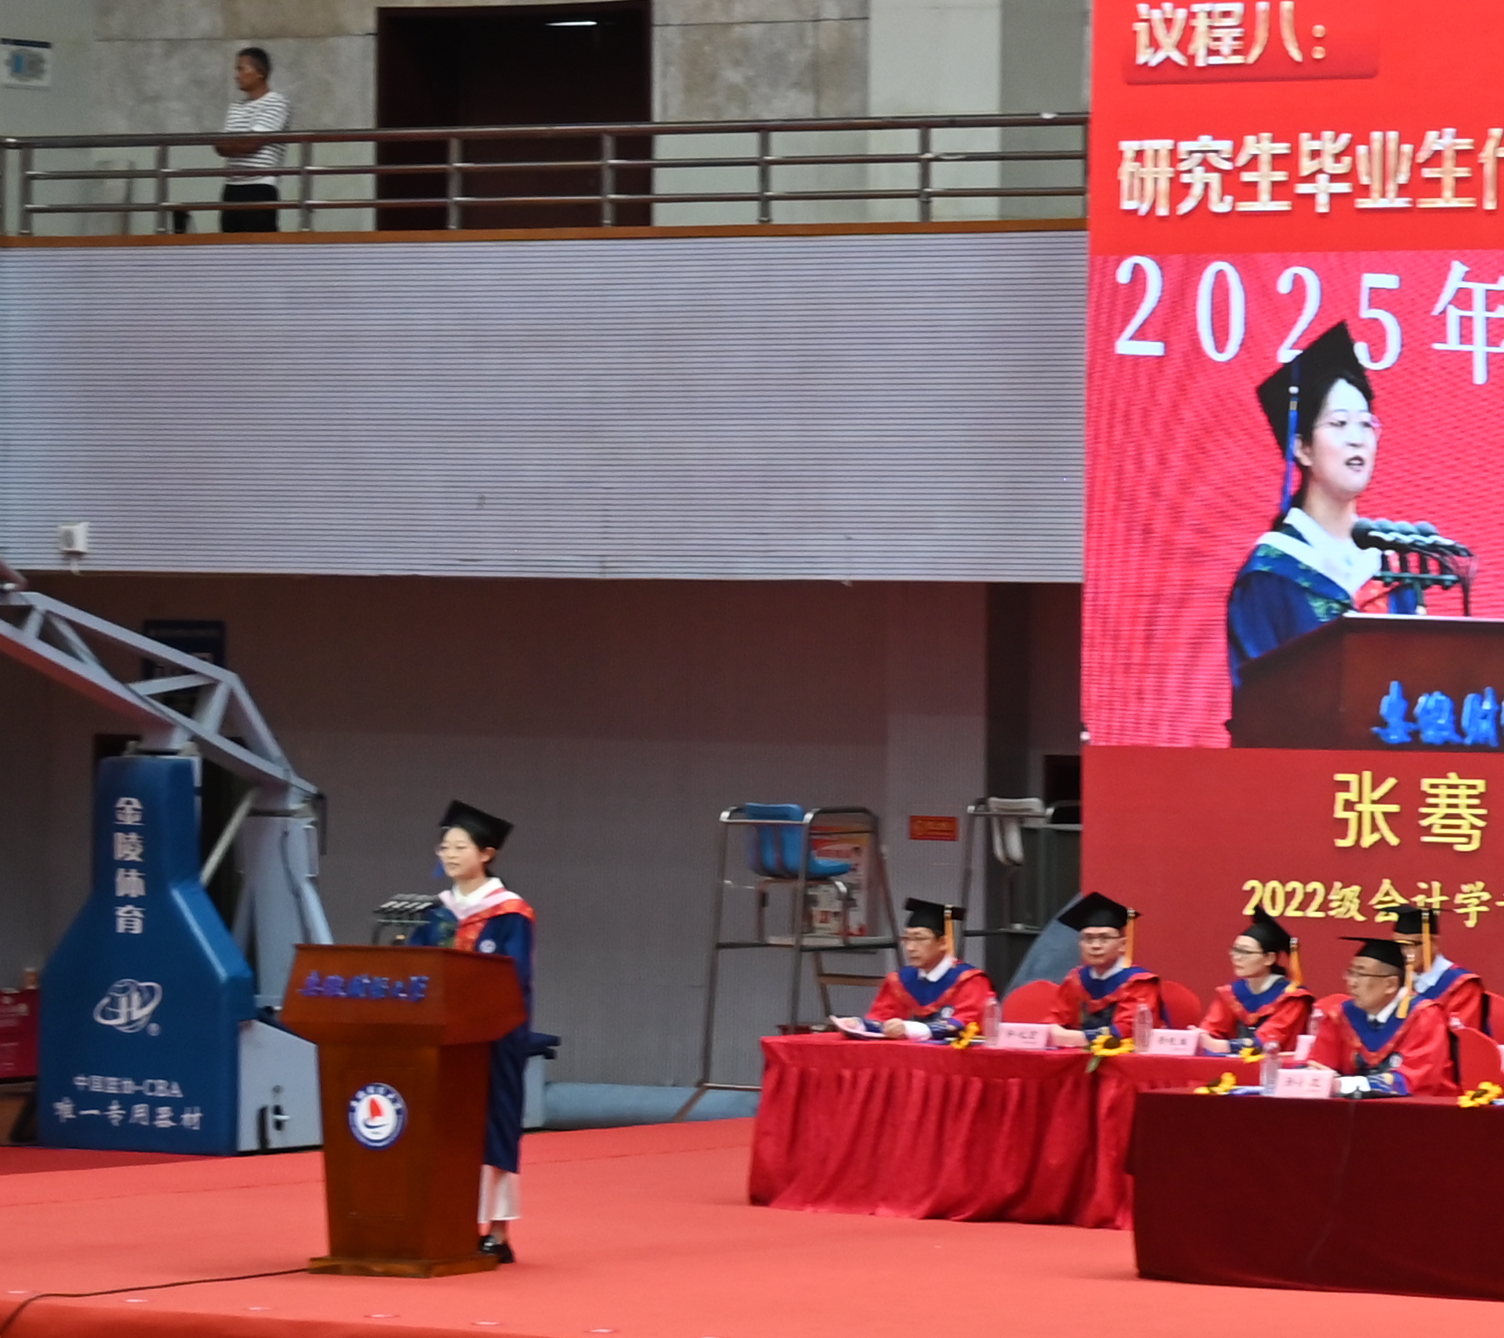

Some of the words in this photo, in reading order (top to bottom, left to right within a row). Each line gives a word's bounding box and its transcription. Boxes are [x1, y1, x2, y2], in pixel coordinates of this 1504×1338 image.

[1132, 0, 1326, 67] 议程八：
[1333, 770, 1488, 852] 张骞
[114, 796, 146, 935] 金陵体育
